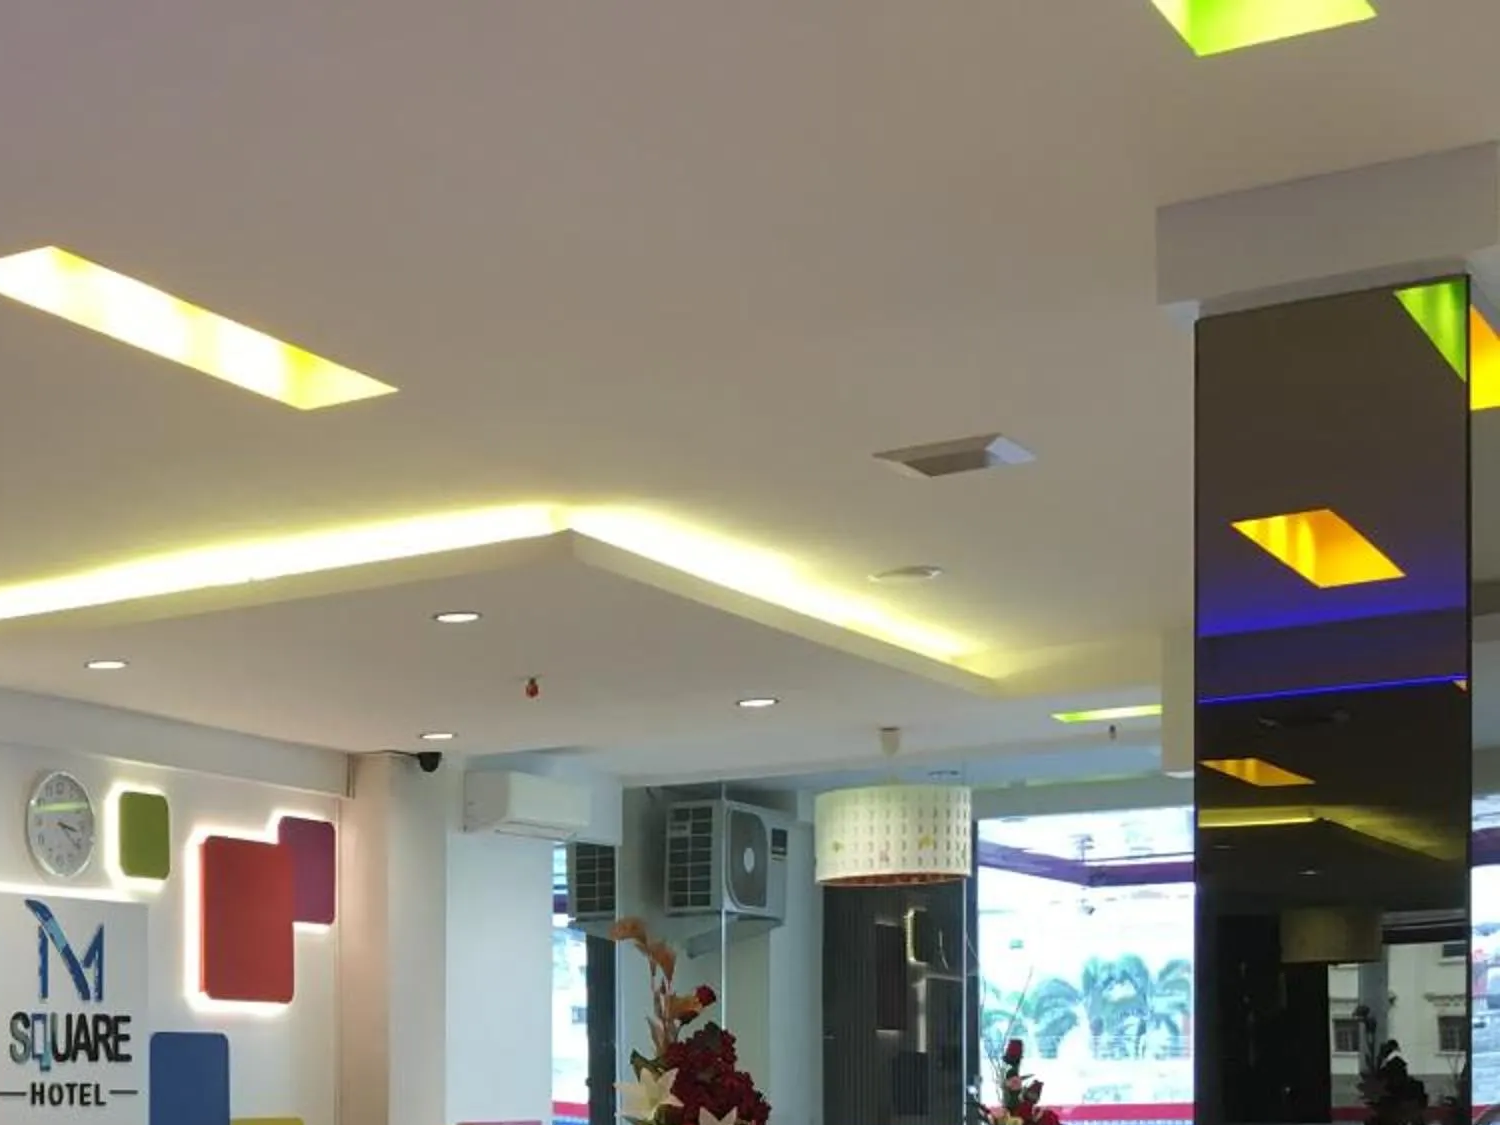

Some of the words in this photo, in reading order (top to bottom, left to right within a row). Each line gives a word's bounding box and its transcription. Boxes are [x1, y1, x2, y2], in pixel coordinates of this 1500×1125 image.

[25, 899, 105, 1003] M
[9, 1011, 132, 1071] SQUARE
[30, 1081, 107, 1107] HOTEL
